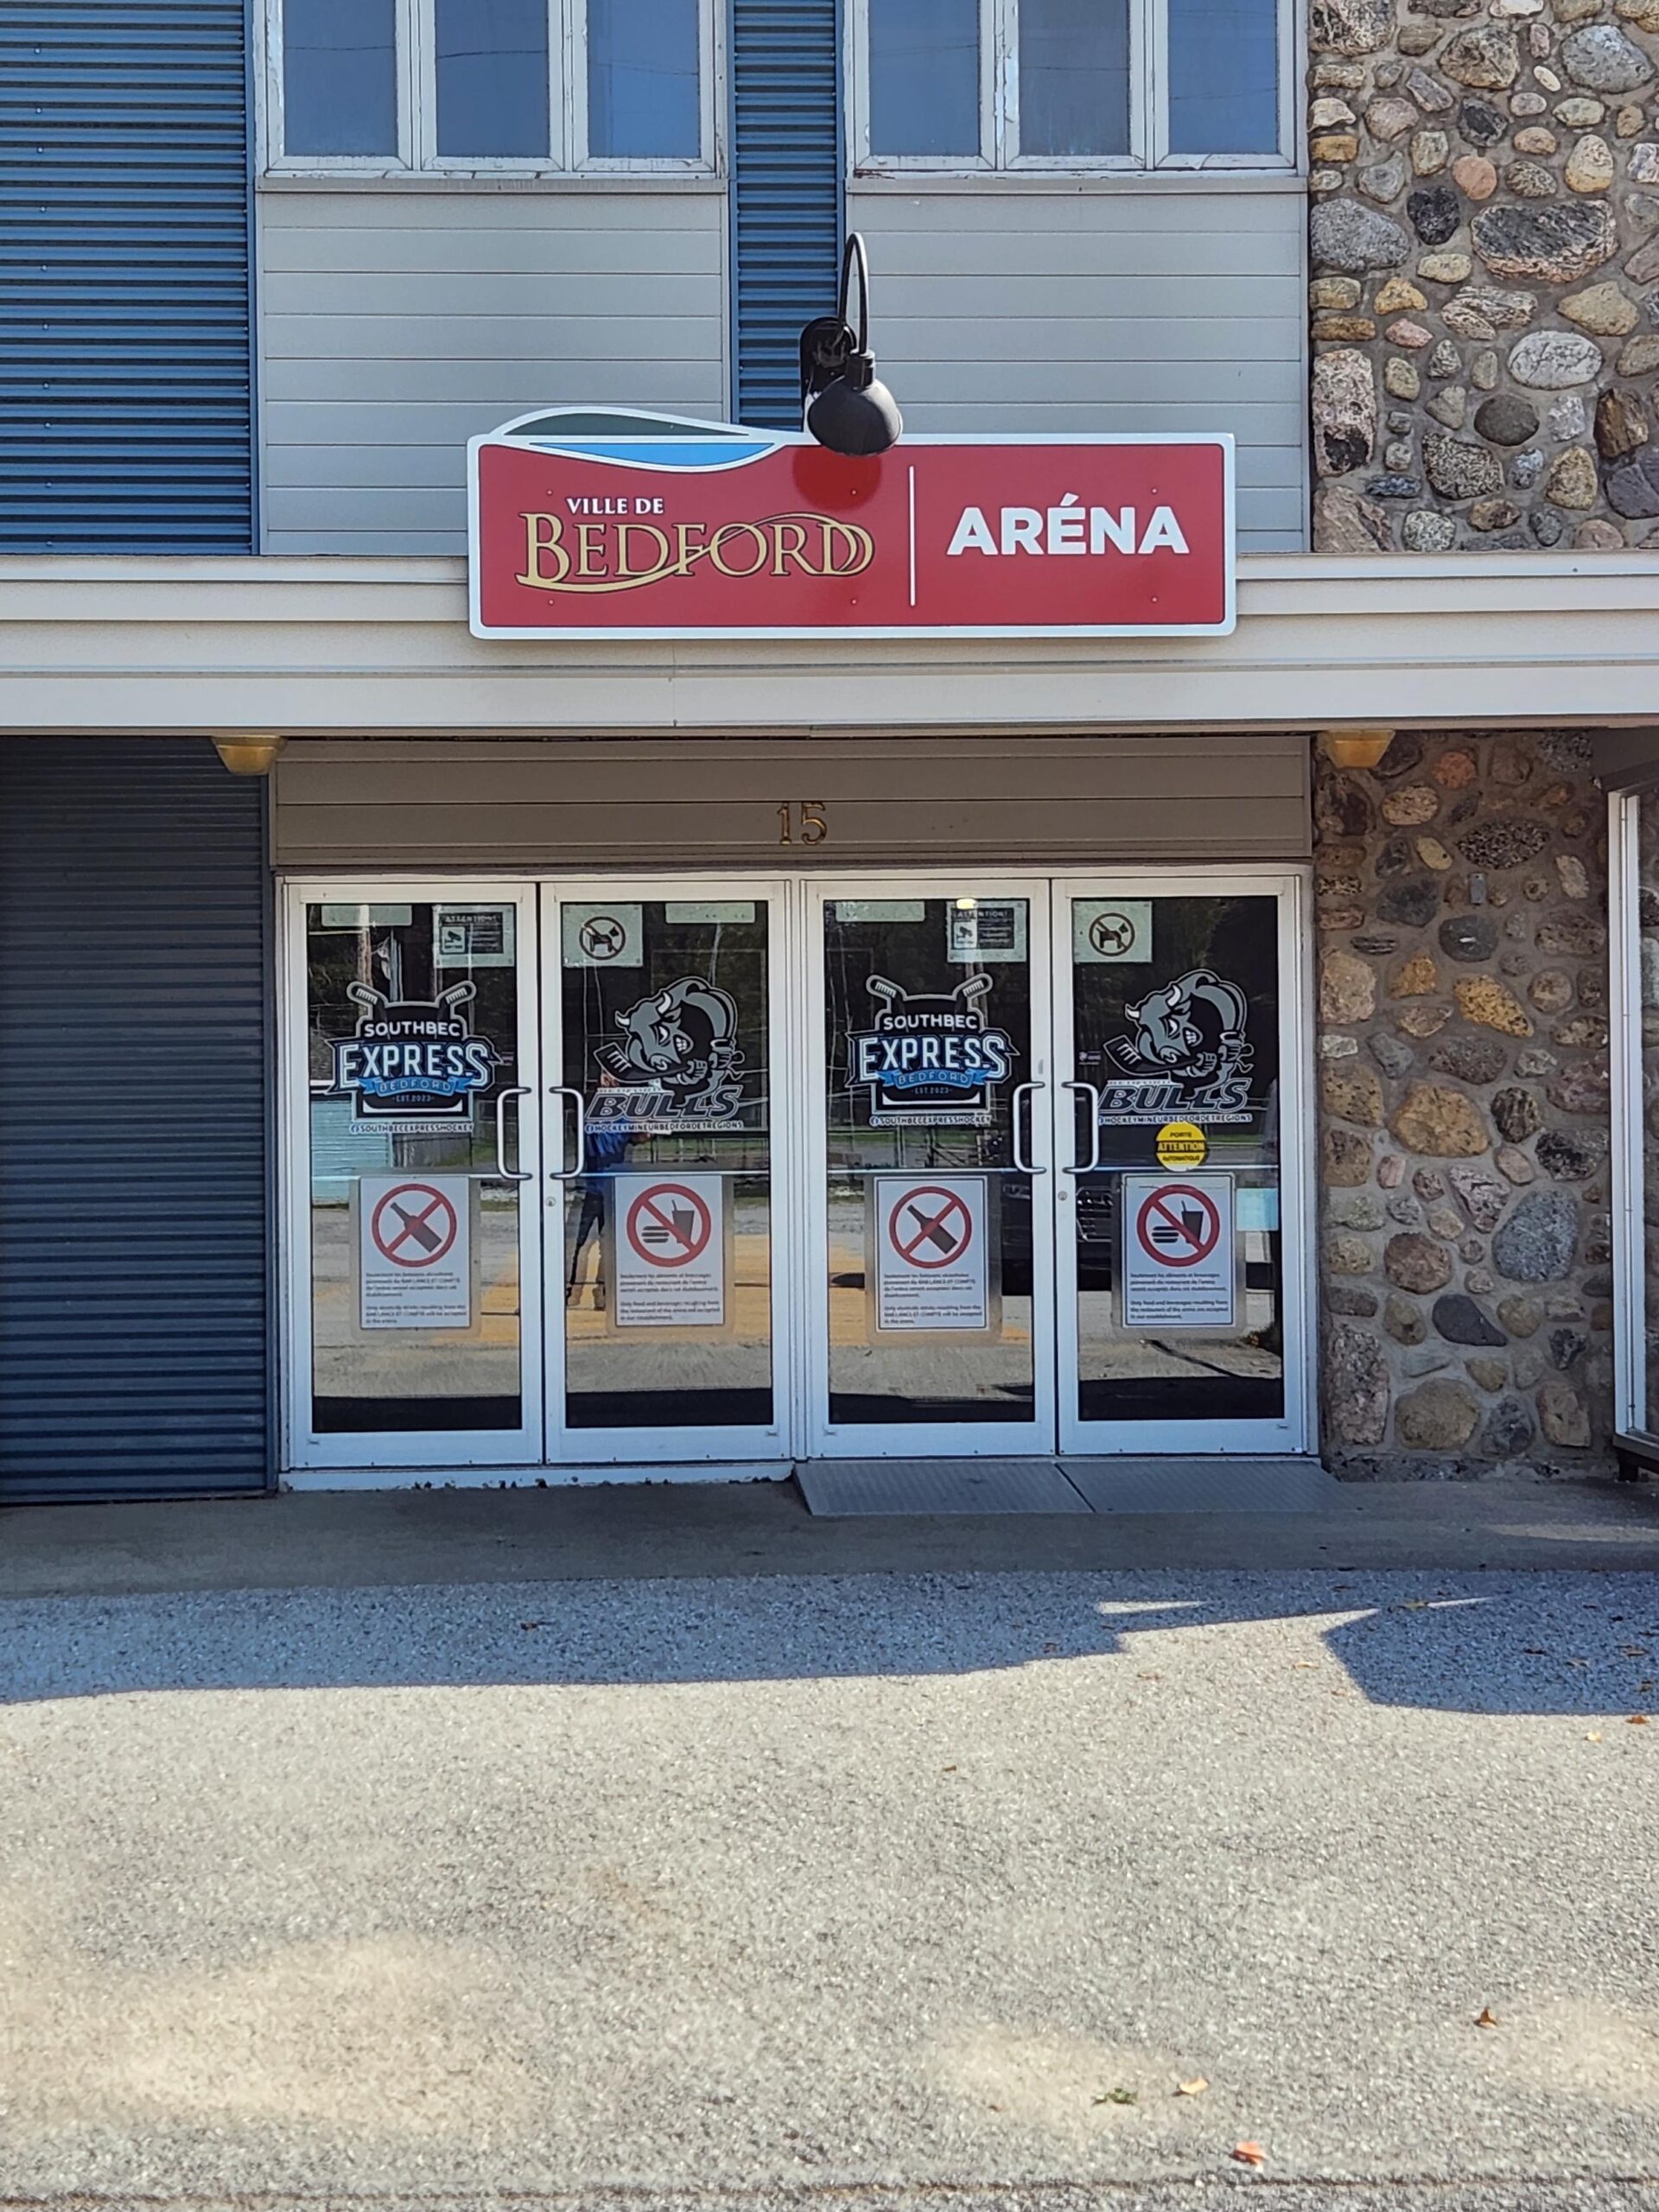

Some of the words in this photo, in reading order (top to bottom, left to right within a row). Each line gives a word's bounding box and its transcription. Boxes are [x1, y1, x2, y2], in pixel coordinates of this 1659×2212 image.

[566, 498, 627, 515] VILLE
[635, 498, 664, 515] DE
[946, 493, 1191, 556] ARÉNA
[516, 512, 875, 594] BEDFORD
[777, 801, 828, 846] 15
[364, 1020, 461, 1037] SOUTHBEC
[883, 1014, 977, 1030] SOUTHBEC
[340, 1043, 488, 1089] EXPRESS
[859, 1036, 1005, 1081] EXPRESS
[379, 1079, 452, 1092] BEDFORD
[898, 1072, 969, 1084] BEDFORD
[1098, 1077, 1253, 1114] BULLS
[585, 1085, 744, 1122] BULLS
[1157, 1142, 1205, 1151] ATTENTION
